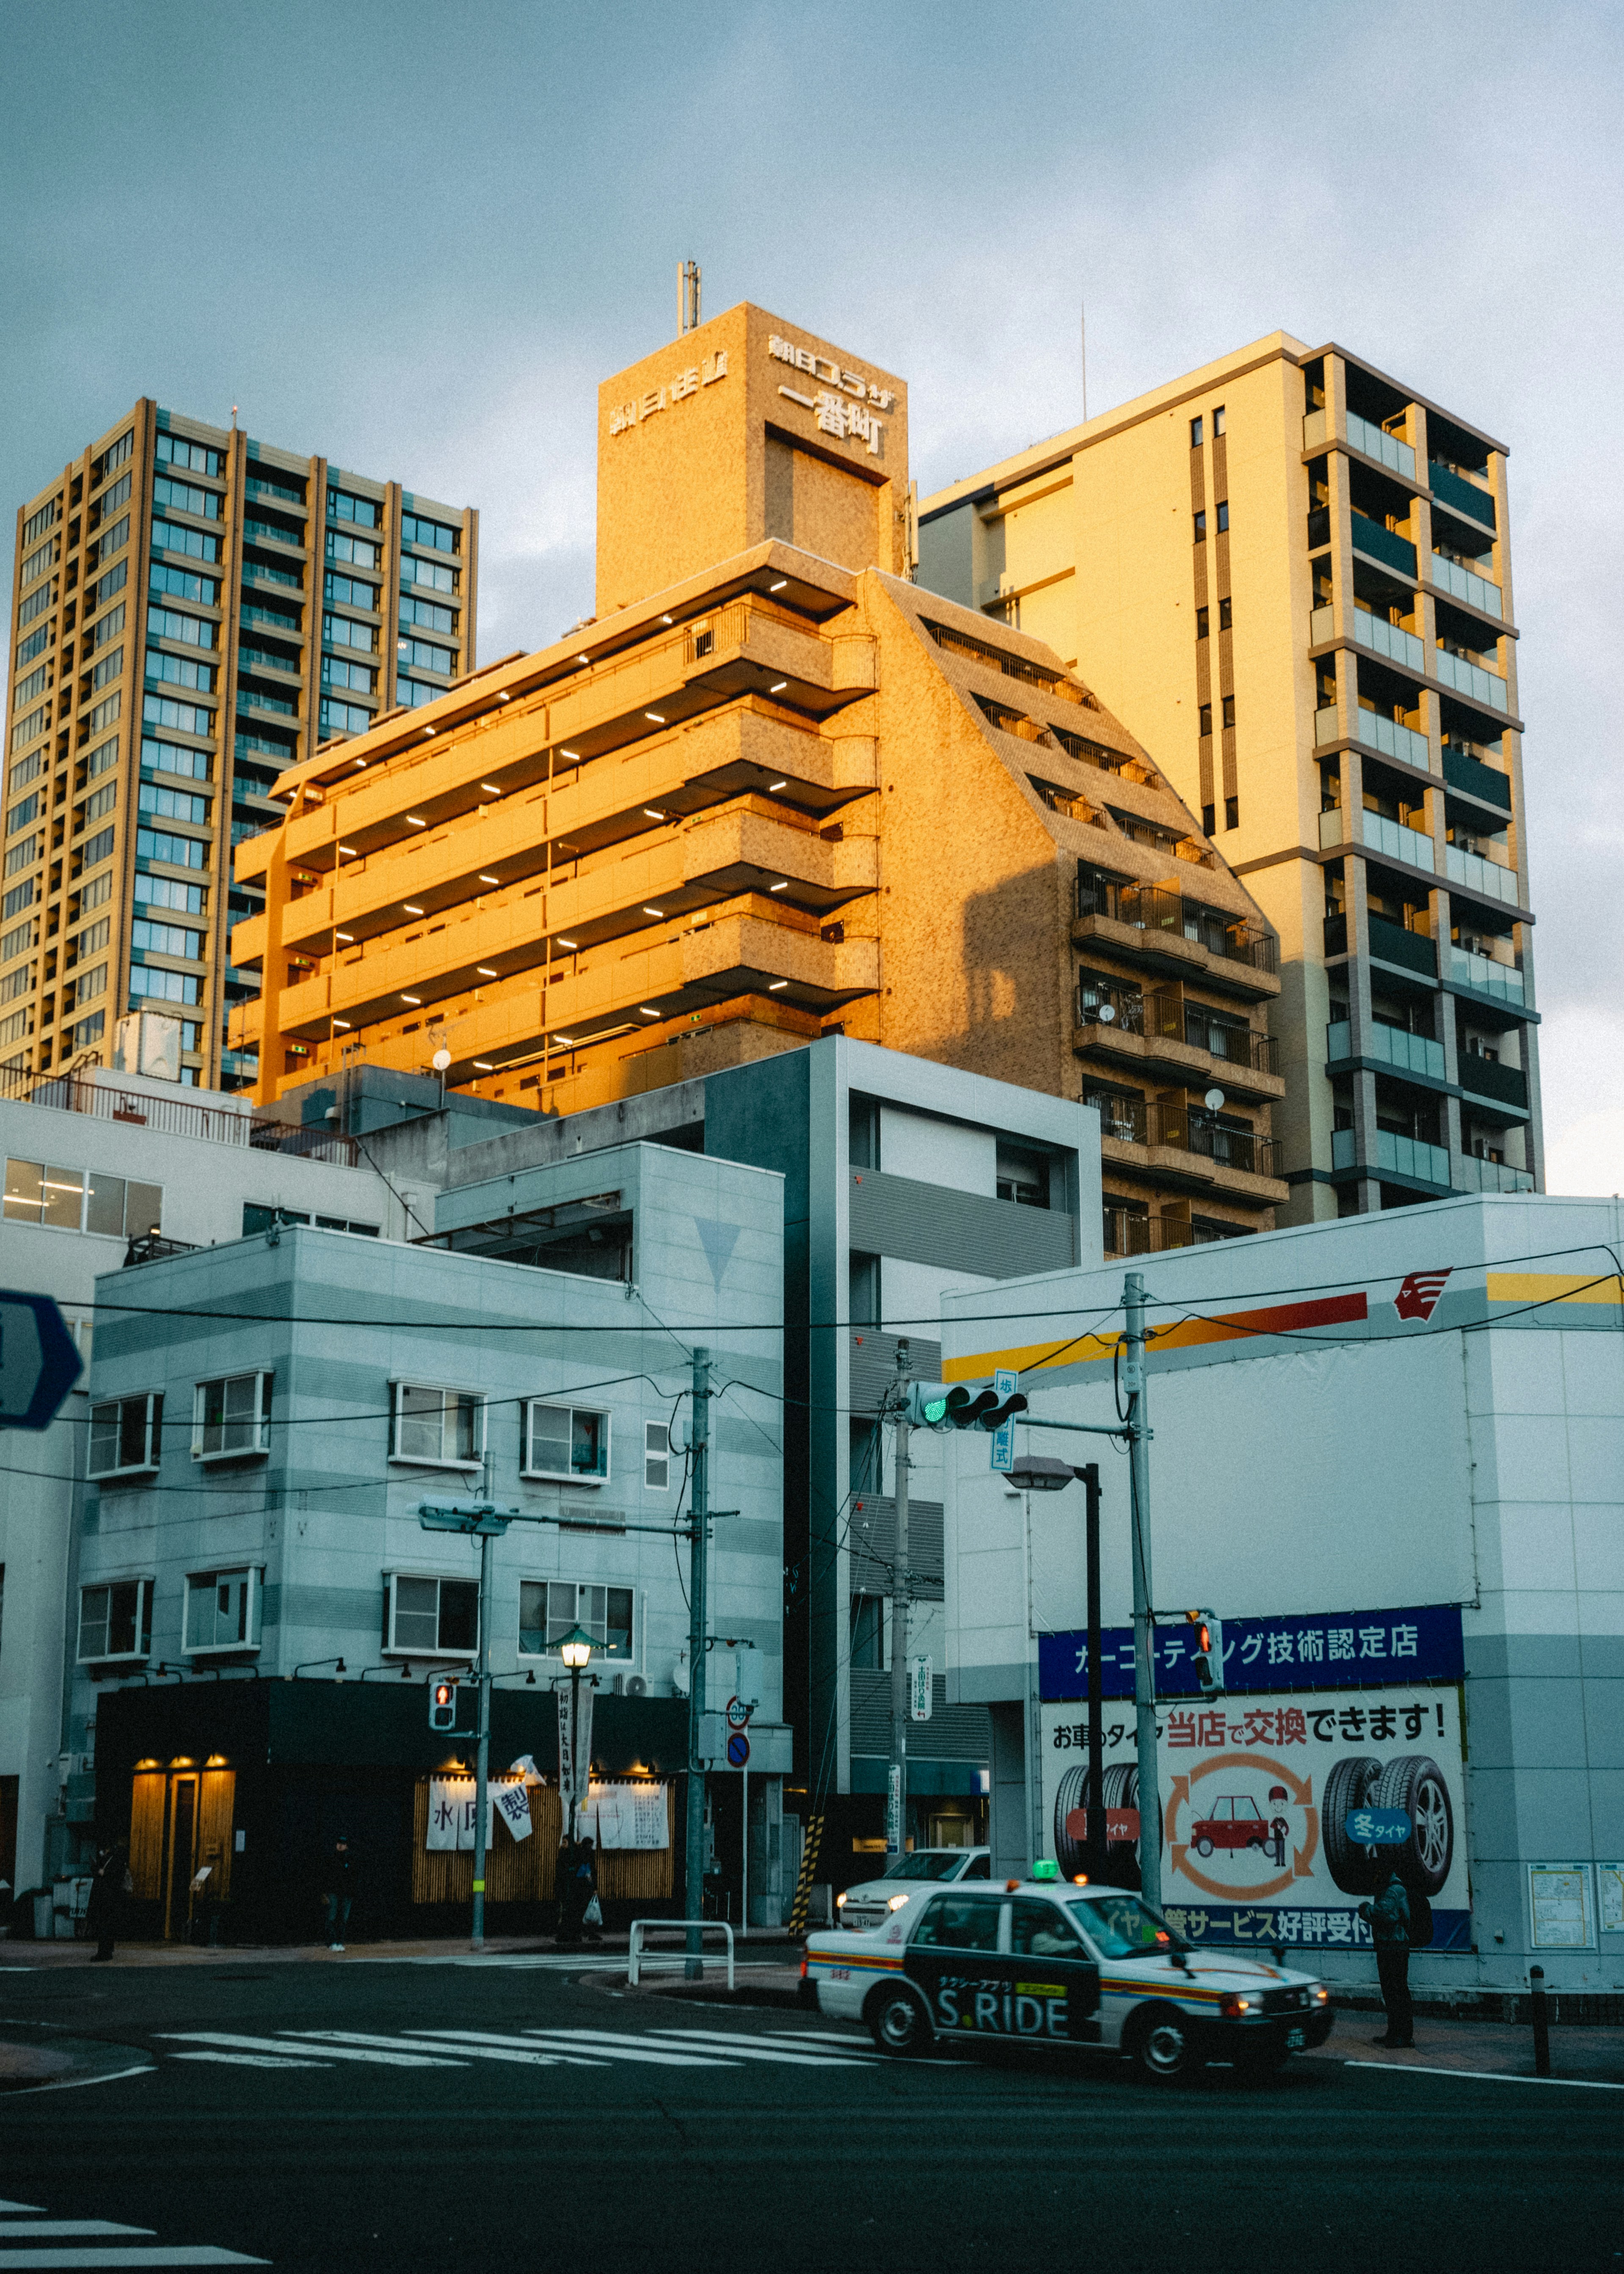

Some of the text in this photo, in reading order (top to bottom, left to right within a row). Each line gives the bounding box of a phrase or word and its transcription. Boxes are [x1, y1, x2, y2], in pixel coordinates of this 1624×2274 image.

[769, 334, 894, 410] 朝日プラザ
[778, 385, 882, 455] 一番町
[996, 1379, 1012, 1464] 歩離式
[1074, 1624, 1418, 1675] カーコテング技術認定店
[732, 1706, 745, 1720] 30
[1354, 1813, 1405, 1839] 冬タイヤ
[939, 1975, 1012, 1993] タクシーアプリ
[938, 1989, 1069, 2037] S.RIDE
